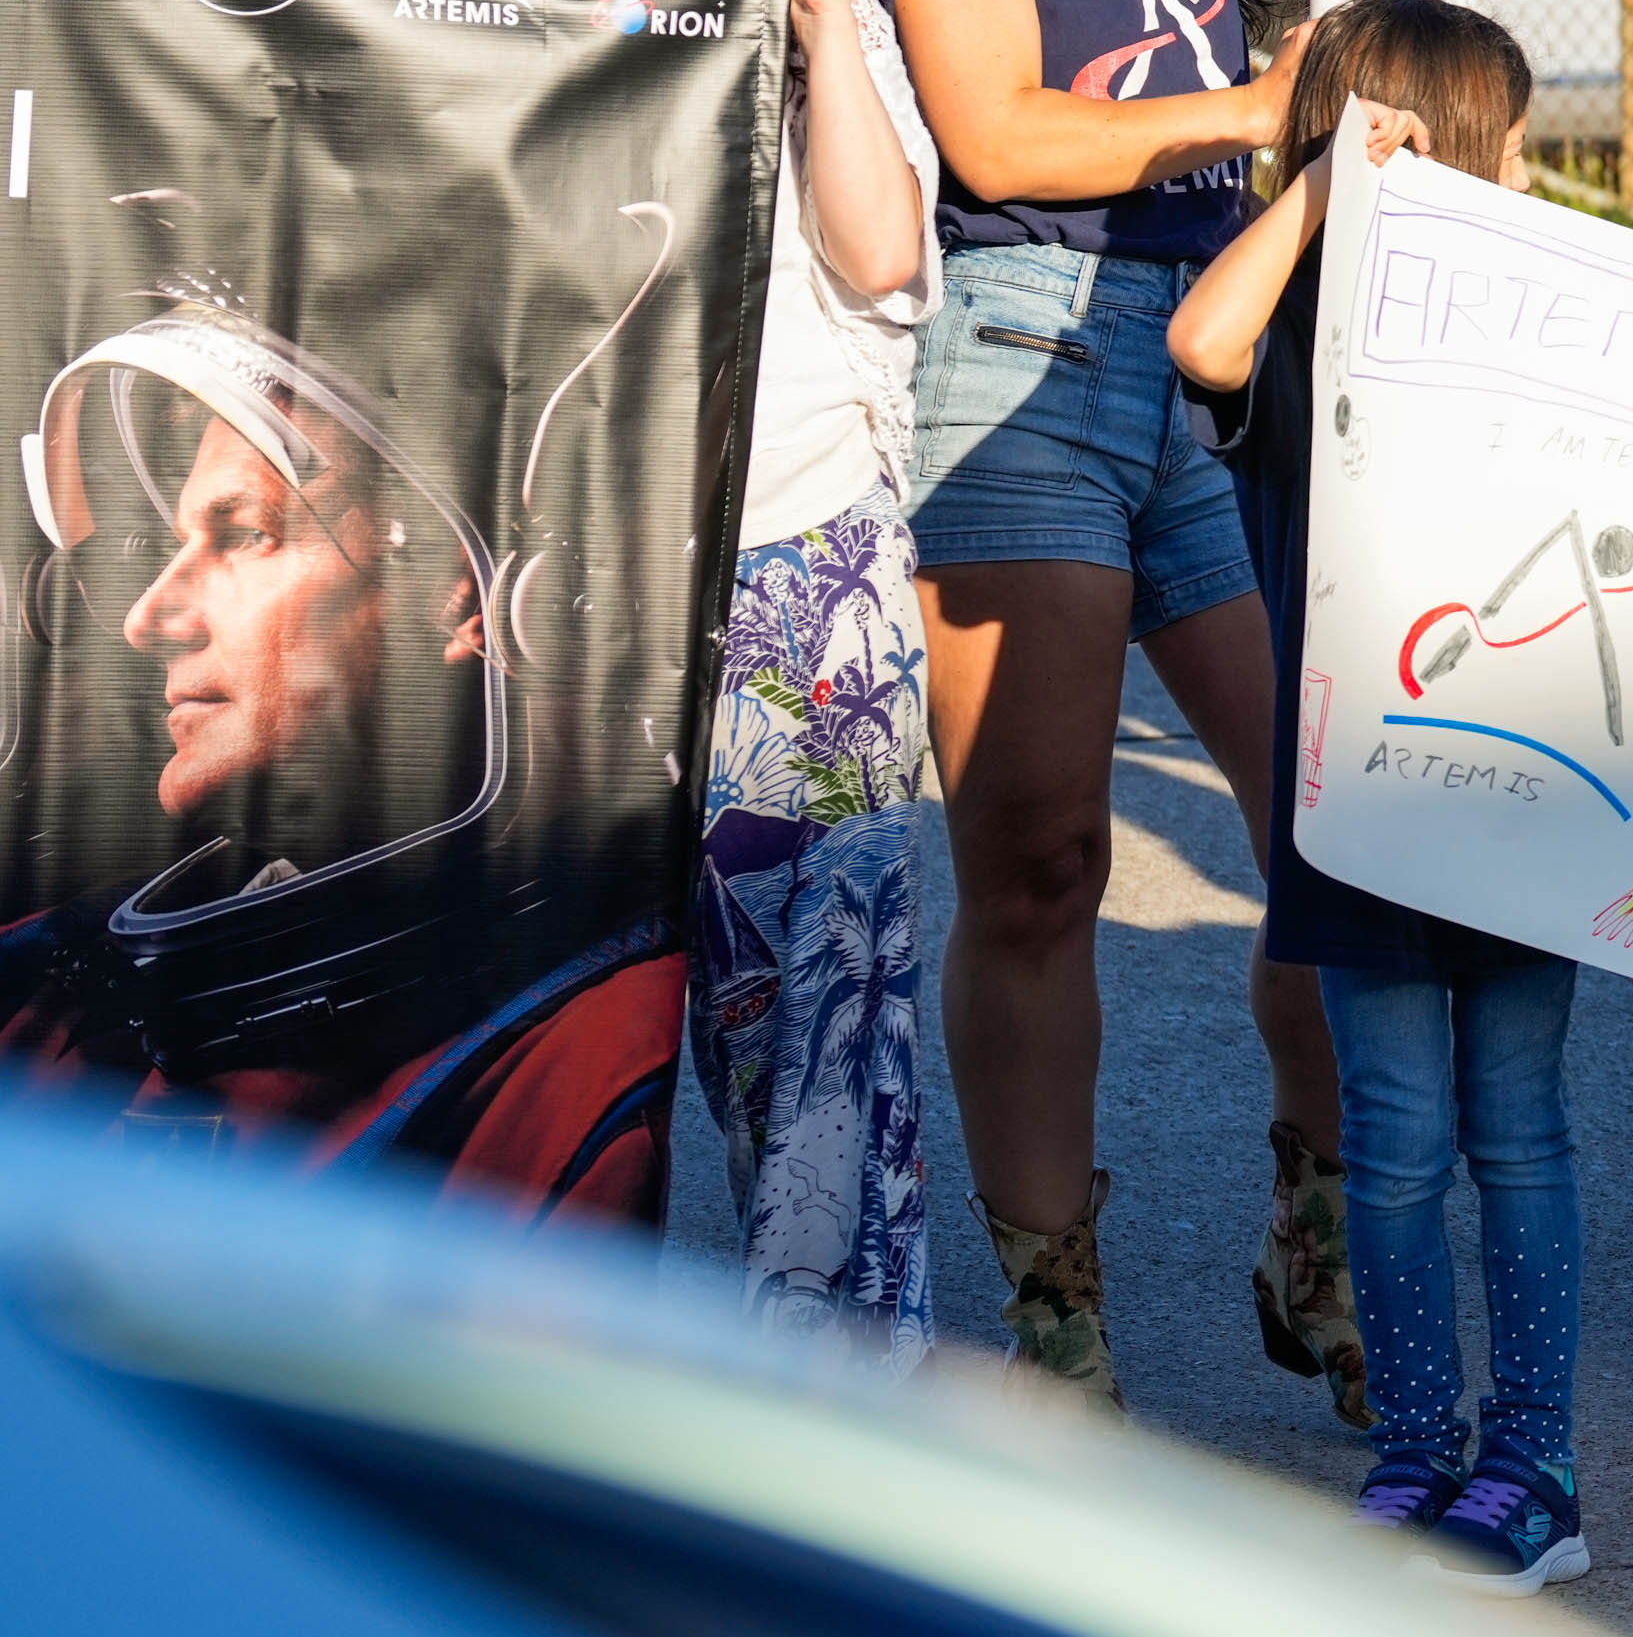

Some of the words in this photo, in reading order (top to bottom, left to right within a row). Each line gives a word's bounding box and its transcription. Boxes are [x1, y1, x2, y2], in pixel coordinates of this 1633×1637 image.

[1487, 421, 1506, 452] I
[1544, 425, 1587, 462] AM
[1364, 741, 1546, 804] ARTEMIS
